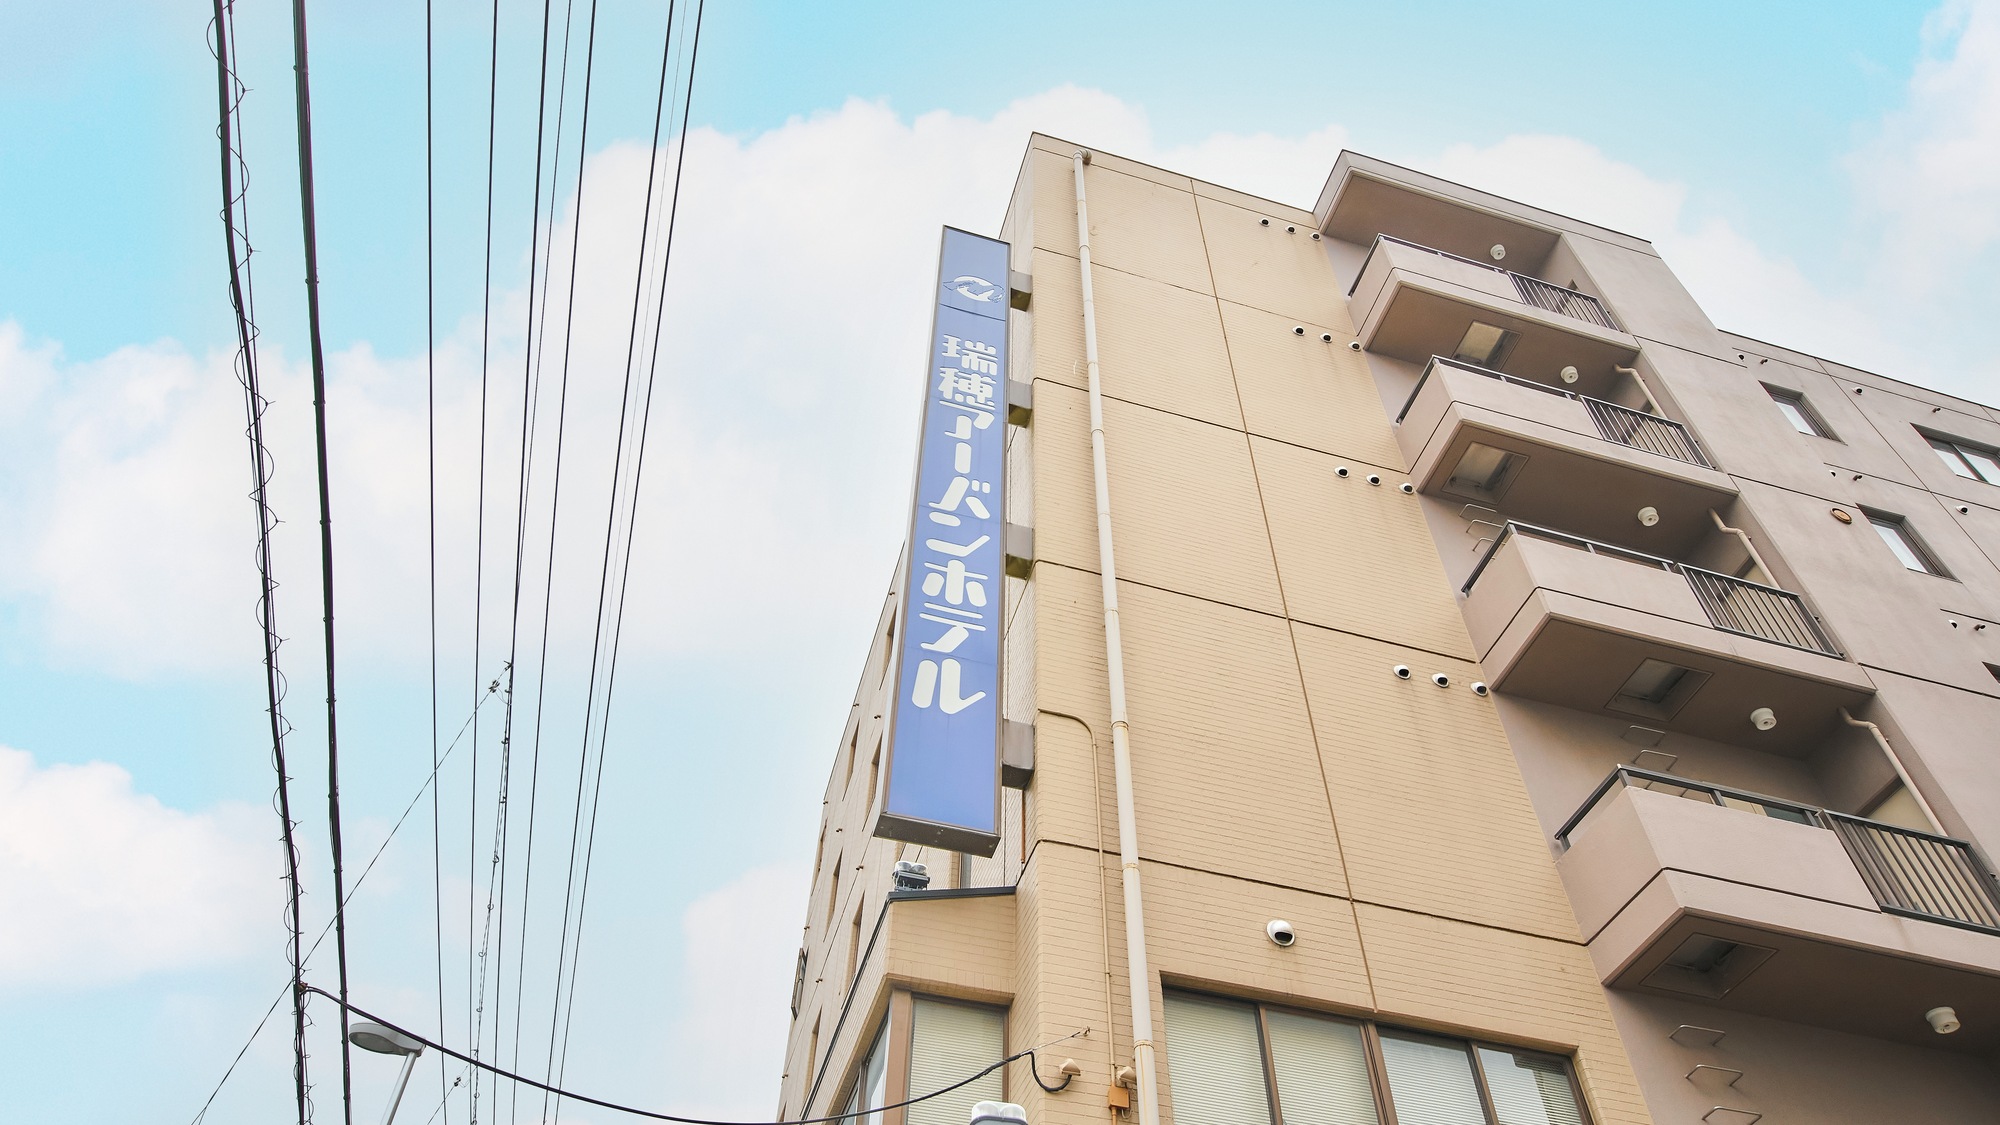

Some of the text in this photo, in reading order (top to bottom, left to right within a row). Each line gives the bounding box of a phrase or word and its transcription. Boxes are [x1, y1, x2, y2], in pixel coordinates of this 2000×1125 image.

[912, 334, 998, 714] 瑞穂アーバンホテル
